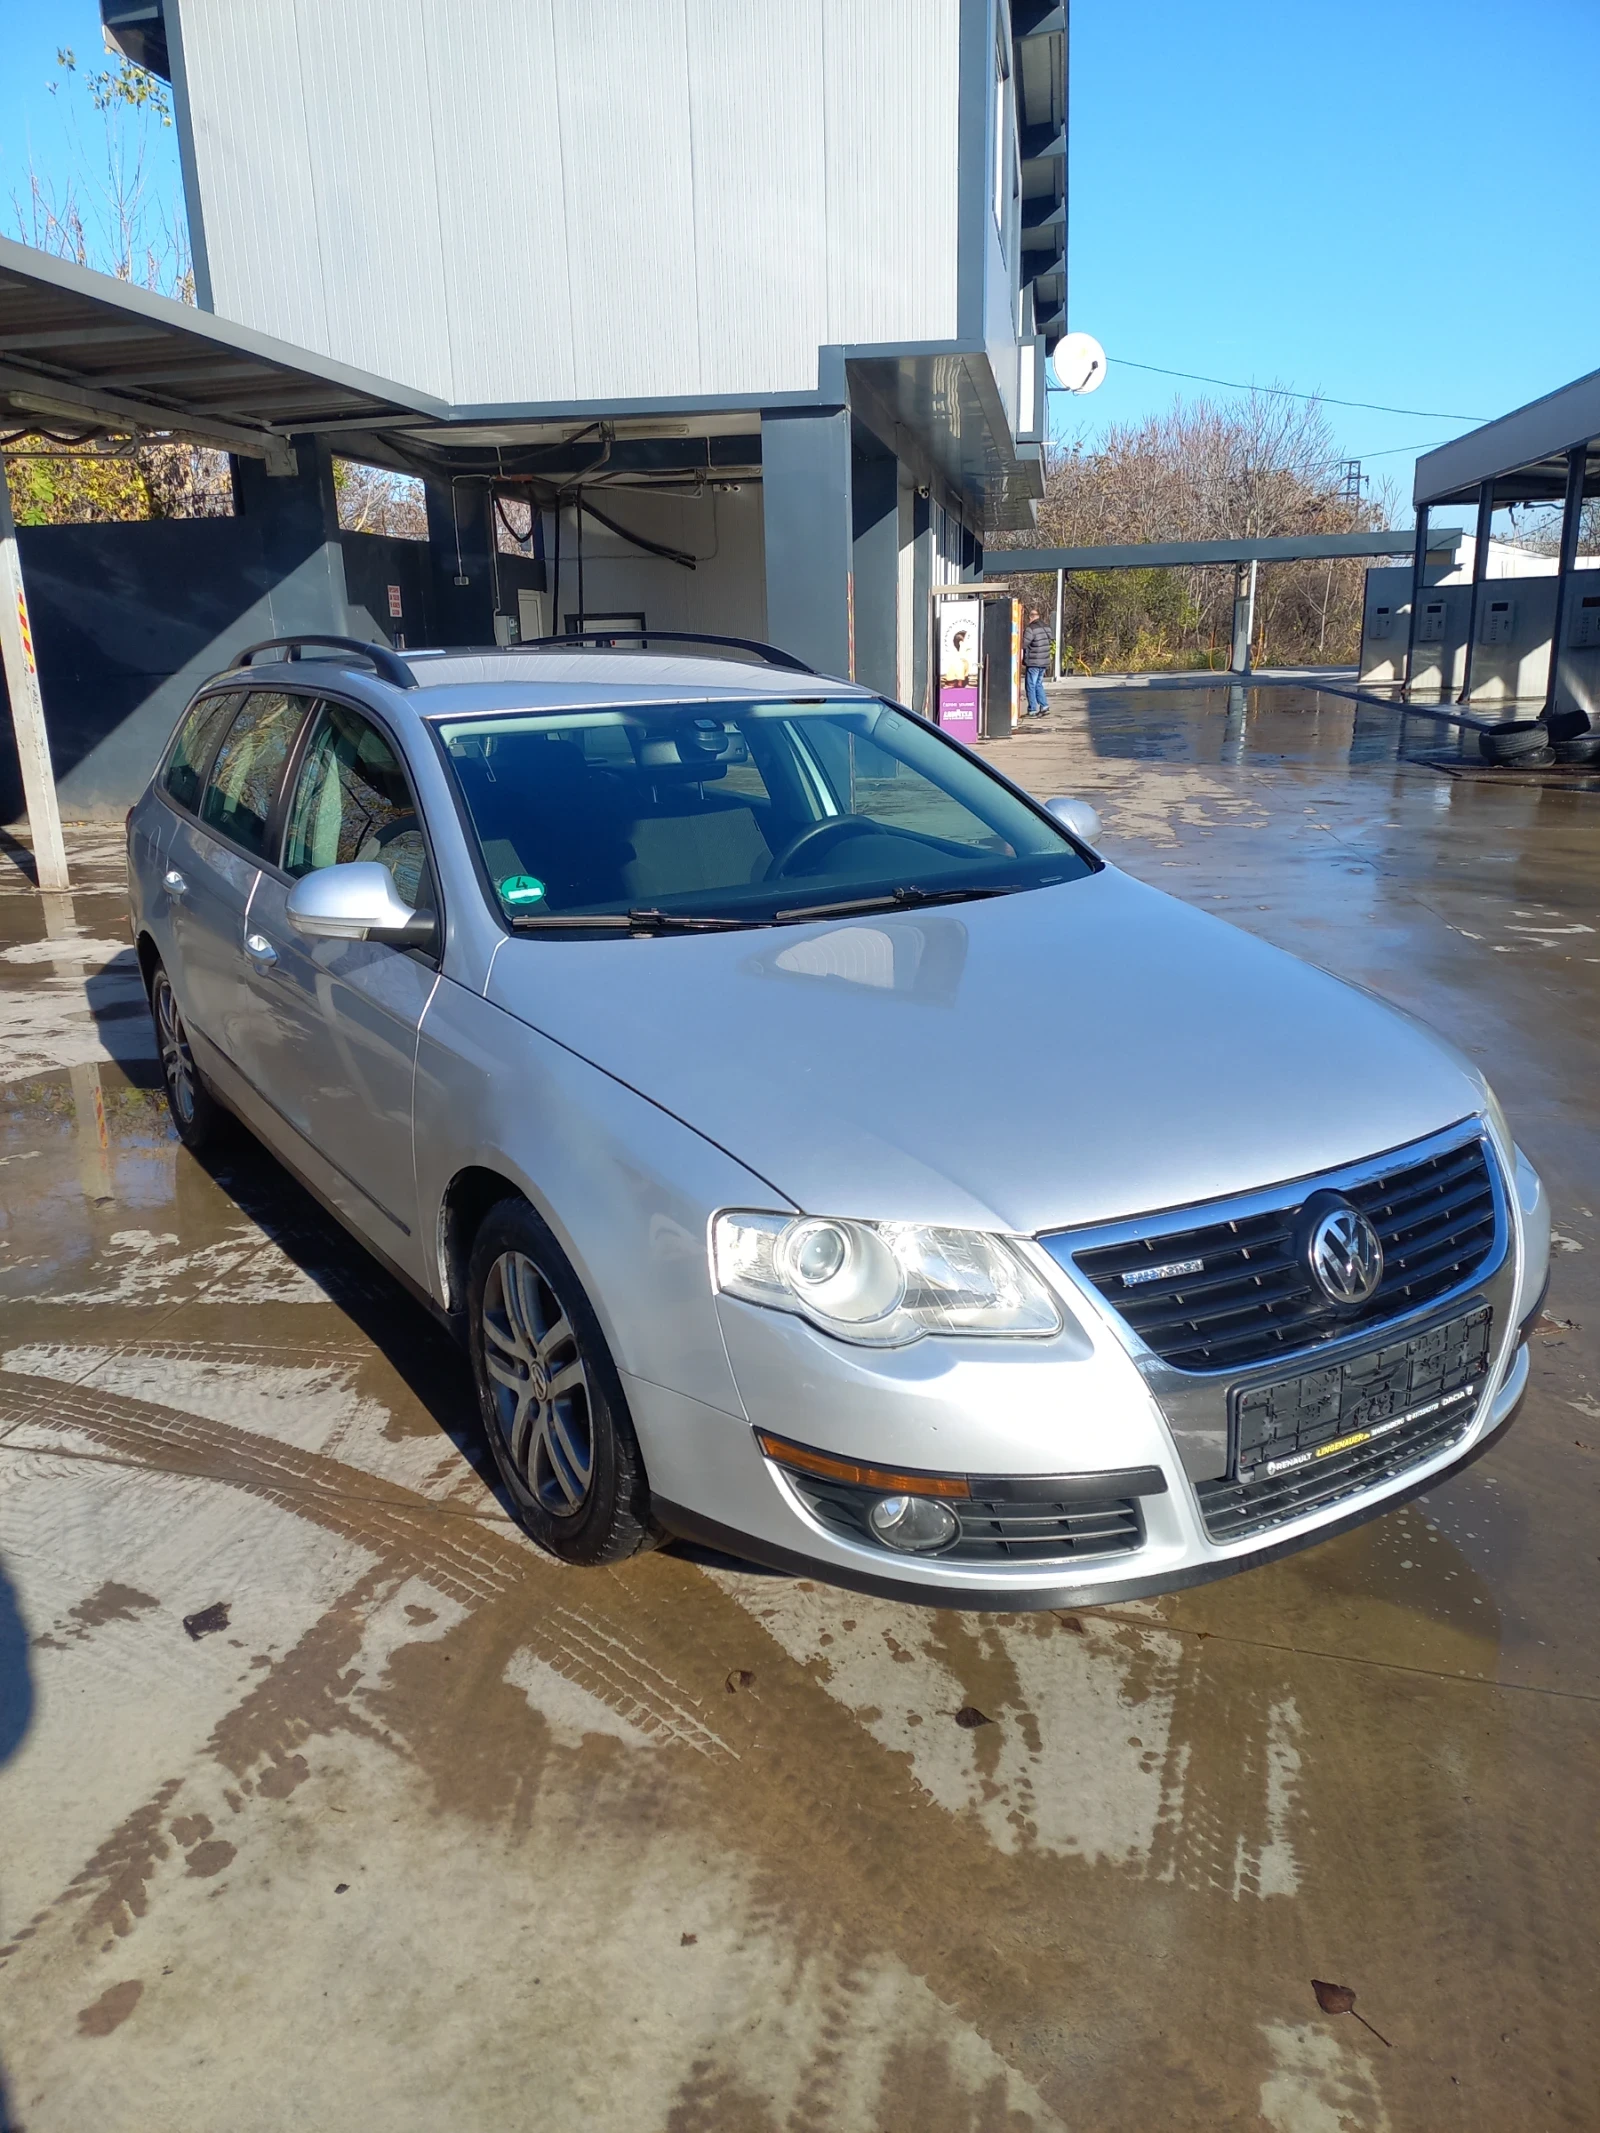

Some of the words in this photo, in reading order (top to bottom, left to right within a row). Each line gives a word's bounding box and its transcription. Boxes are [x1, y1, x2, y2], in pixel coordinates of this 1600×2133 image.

[515, 877, 529, 889] 4
[1276, 1452, 1312, 1471] RENAULT
[1441, 1391, 1466, 1406] DACIA
